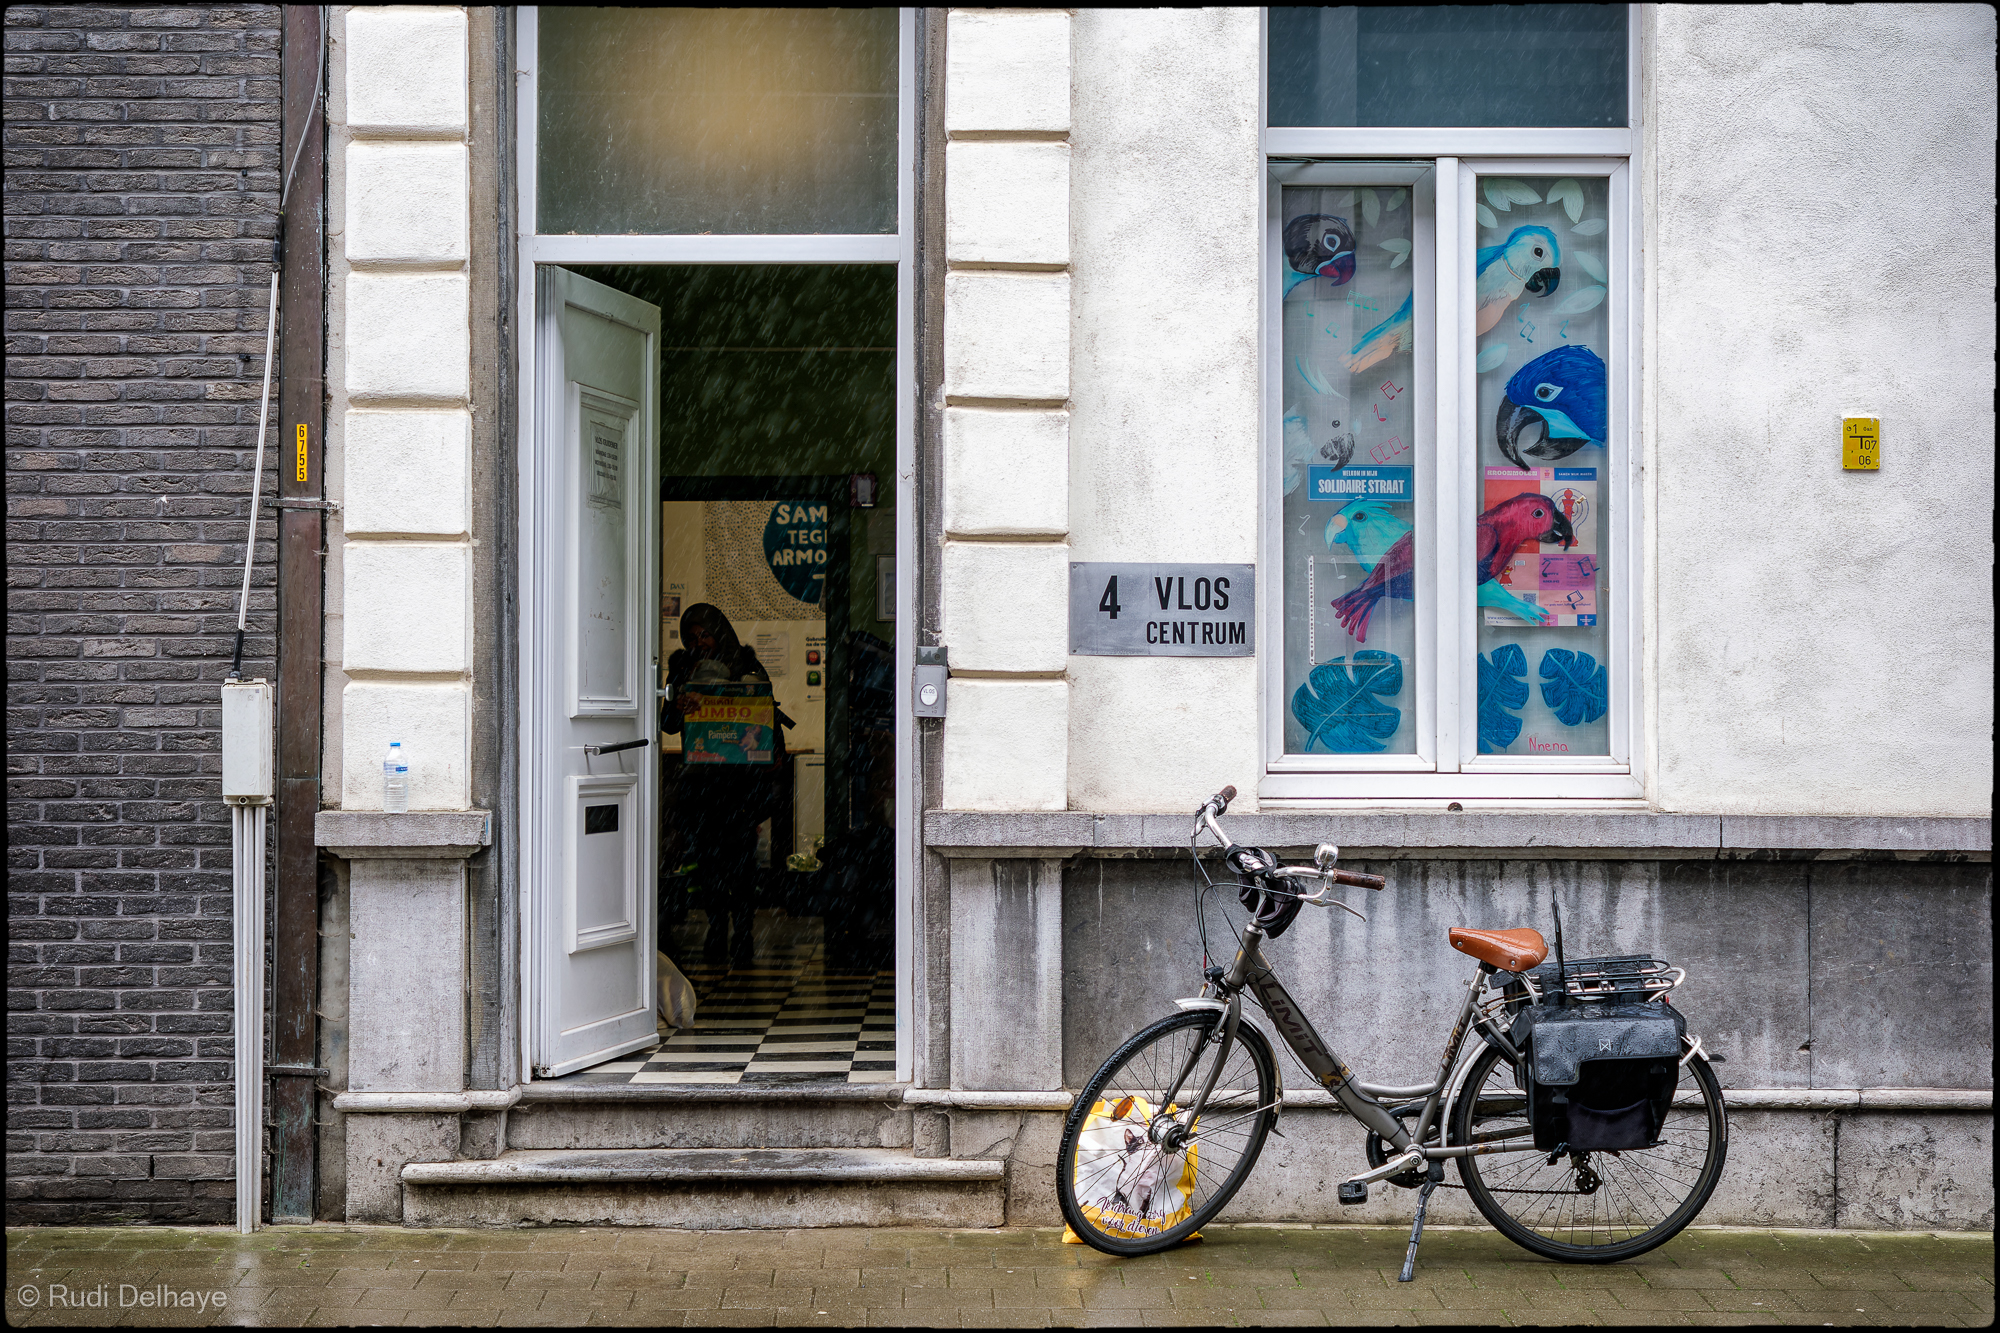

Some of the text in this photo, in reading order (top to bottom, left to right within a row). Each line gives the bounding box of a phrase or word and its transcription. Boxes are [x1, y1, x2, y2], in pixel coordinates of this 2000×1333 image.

[1864, 440, 1877, 450] 07
[1858, 455, 1871, 465] 06
[1318, 479, 1405, 494] SOLIDAIRE STRAAT
[775, 504, 828, 525] SAM
[787, 529, 828, 545] TEG
[772, 548, 827, 566] ARMO
[1098, 575, 1230, 620] 4 VLOS
[1146, 621, 1246, 645] CENTRUM
[708, 730, 738, 742] Pampers
[1529, 737, 1569, 752] Nnena
